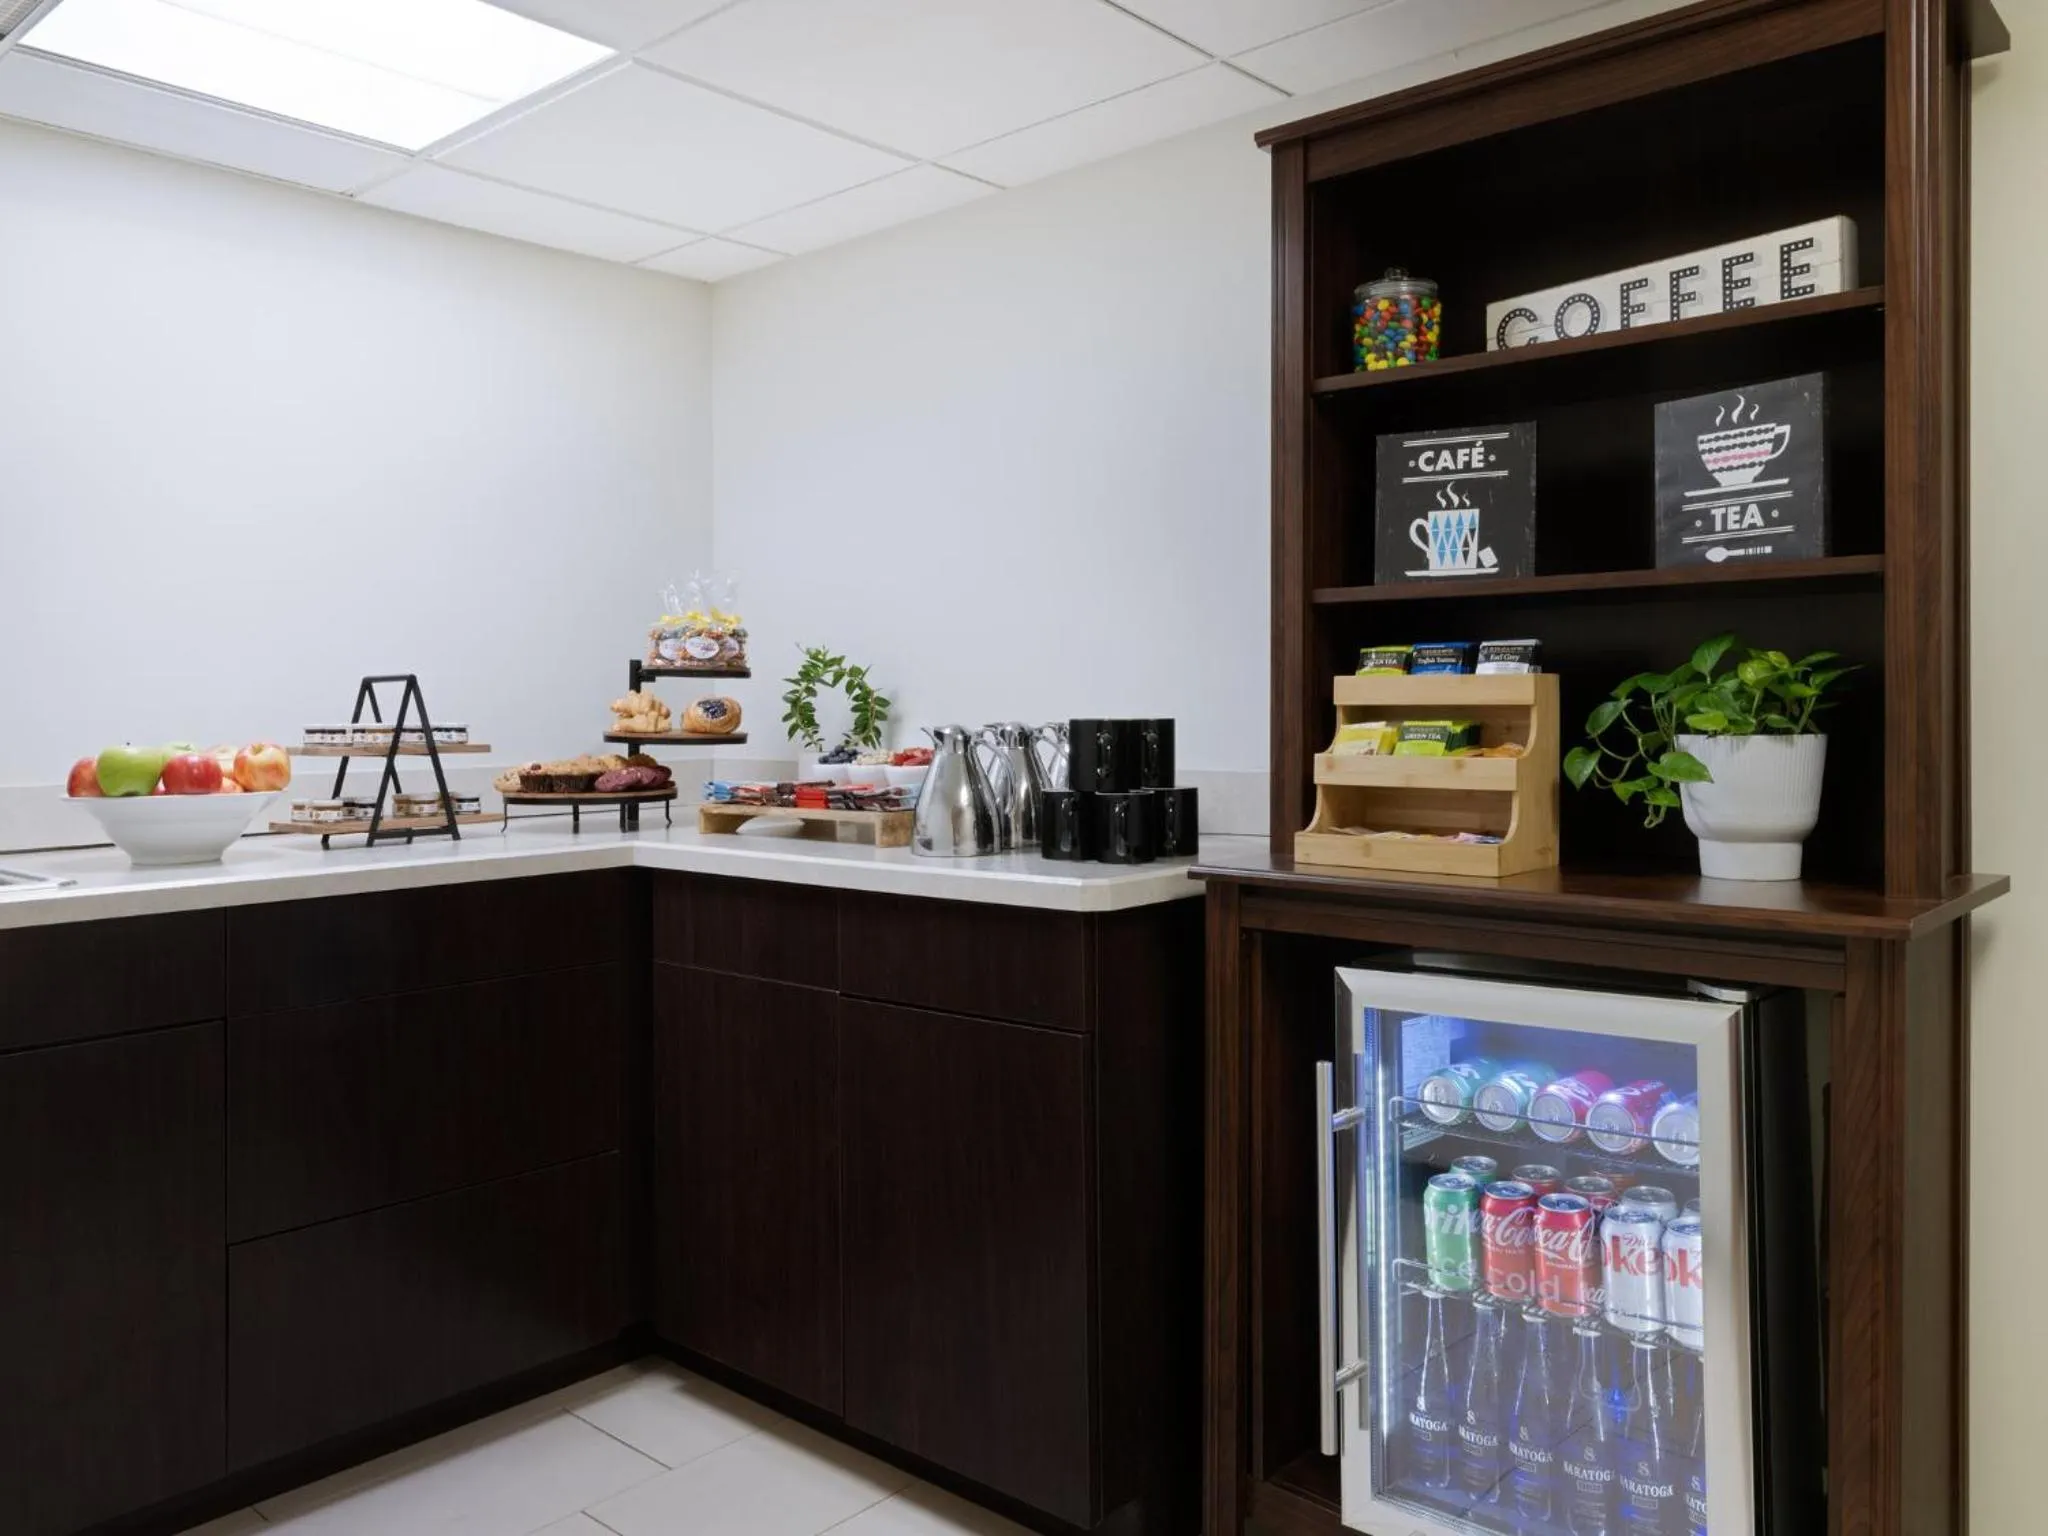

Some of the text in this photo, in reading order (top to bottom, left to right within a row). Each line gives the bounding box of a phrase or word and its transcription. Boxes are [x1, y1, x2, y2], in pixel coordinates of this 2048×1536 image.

[1497, 237, 1814, 350] COFFEE
[1418, 440, 1485, 472] CAFÉ
[1711, 503, 1765, 532] TEA
